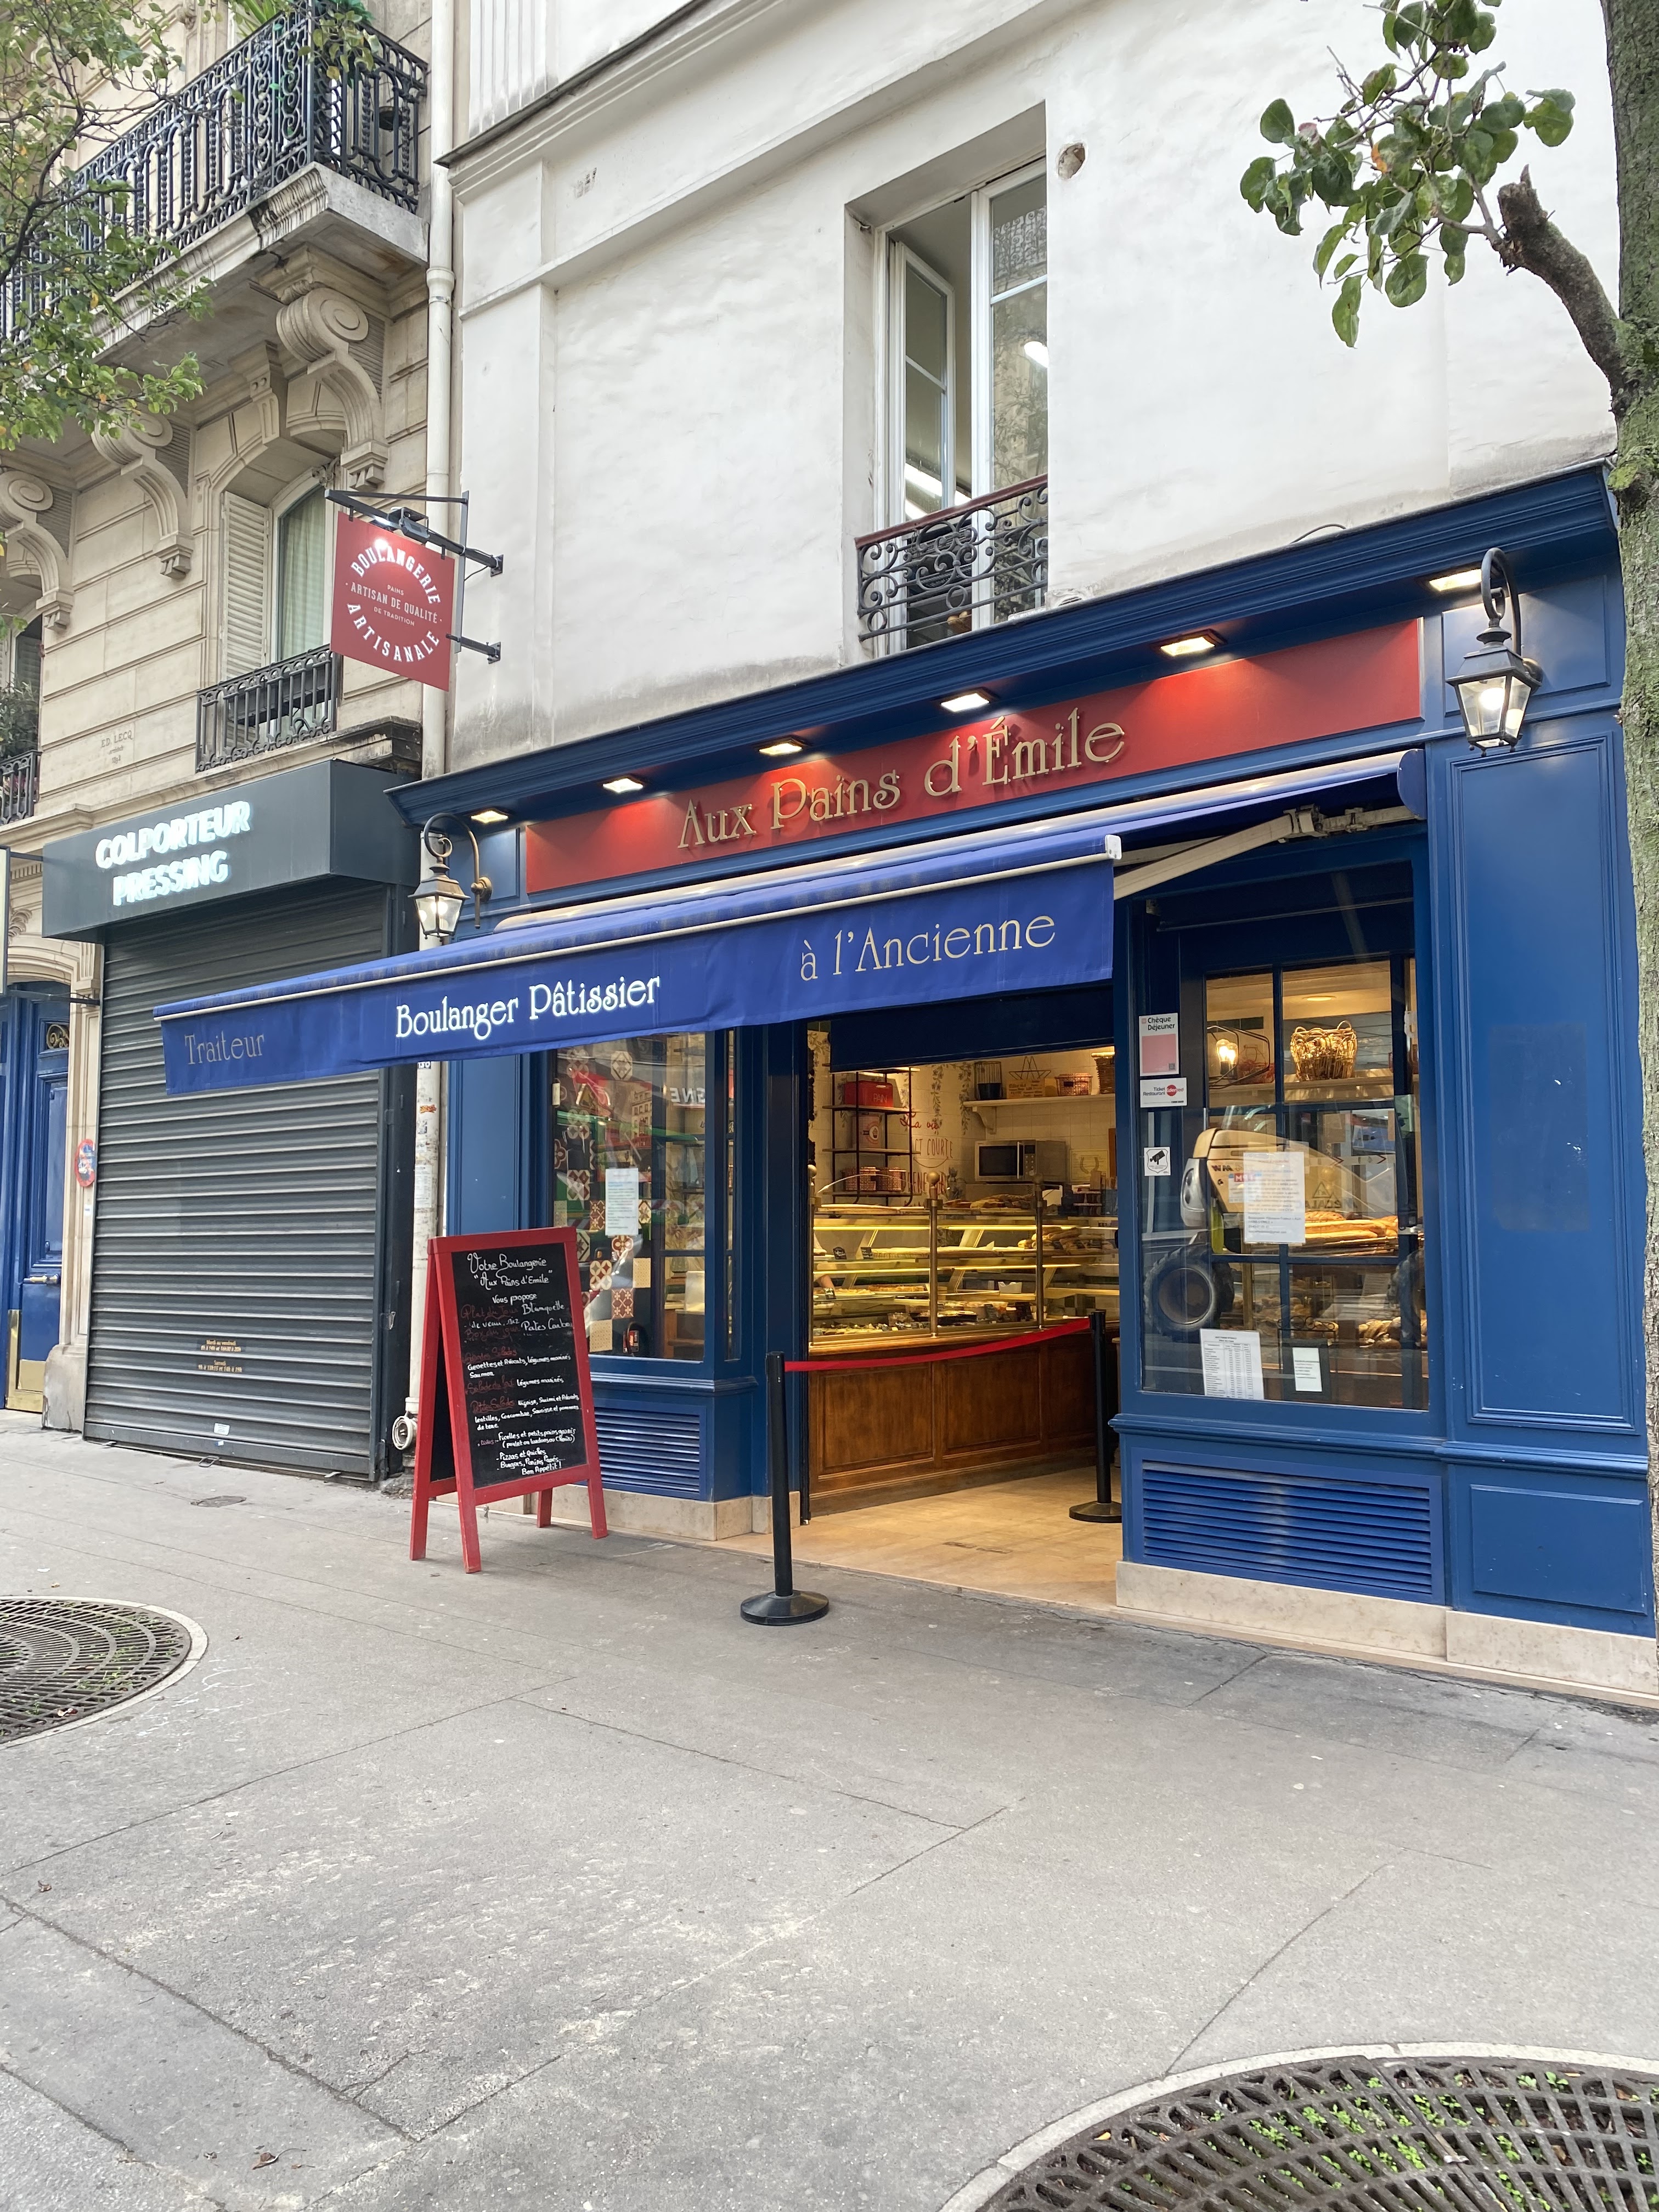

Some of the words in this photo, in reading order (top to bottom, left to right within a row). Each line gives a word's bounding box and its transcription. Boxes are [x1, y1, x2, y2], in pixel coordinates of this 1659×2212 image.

[350, 544, 441, 603] BOULANGERIE
[387, 584, 404, 595] PAINS
[351, 582, 388, 605] ARTISAN
[391, 596, 400, 610] DE
[404, 602, 437, 624] QUALITÉ
[374, 606, 381, 614] DE
[383, 610, 415, 626] TRADITION
[347, 603, 439, 662] ARTISANALE
[678, 799, 757, 849] Aux
[770, 769, 901, 831] Pains
[924, 707, 1126, 797] d'Émile
[95, 800, 251, 869] COLPORTEUR
[112, 849, 228, 906] PRESSING
[800, 939, 818, 980] à
[832, 915, 1056, 975] l'Ancienne
[396, 996, 519, 1041] Boulanger
[528, 975, 661, 1020] Pâtissier
[1148, 1016, 1171, 1024] Chèque
[1148, 1023, 1176, 1031] Déjeuner
[184, 1029, 266, 1066] Traiteur
[927, 1138, 953, 1159] COURTE
[467, 1252, 498, 1273] Votre
[496, 1254, 547, 1276] Boulangerie
[501, 1276, 520, 1286] Pains
[492, 1295, 508, 1304] Vous
[510, 1293, 537, 1305] propose
[499, 1452, 519, 1461] Pizzas
[522, 1468, 534, 1476] Bon
[535, 1462, 558, 1473] Appétit
